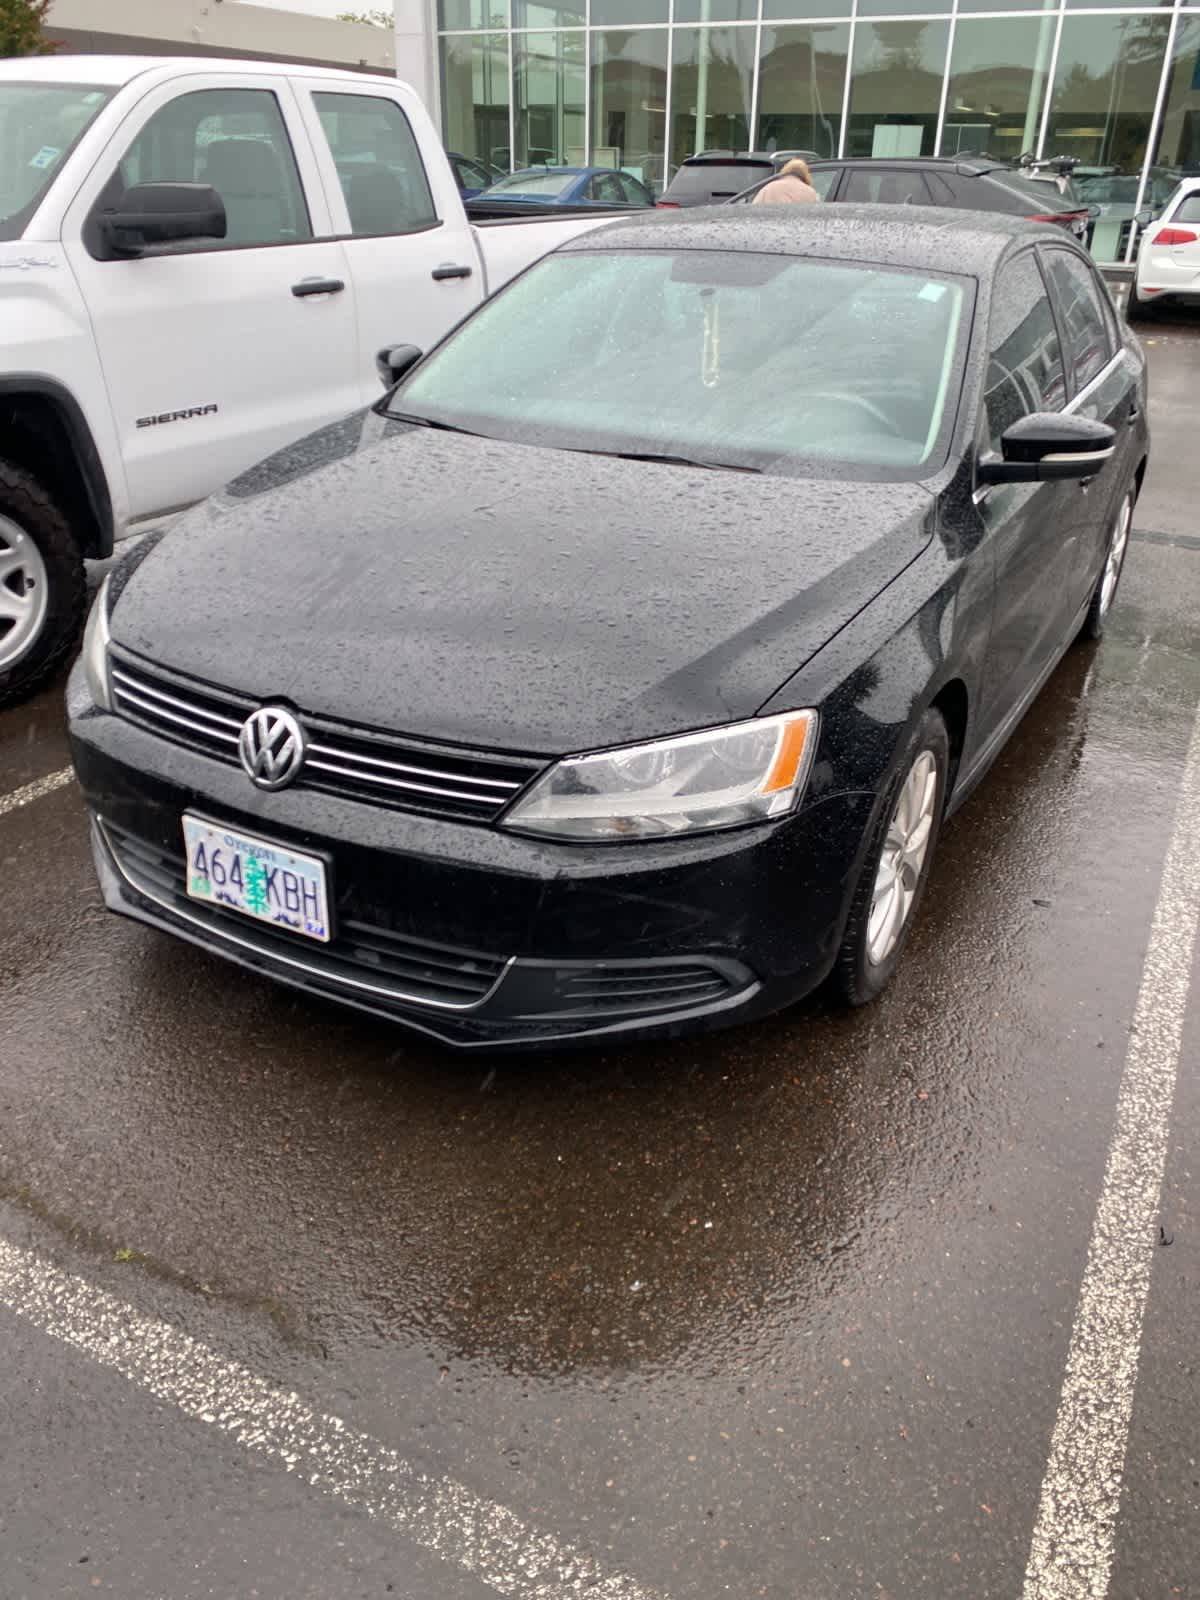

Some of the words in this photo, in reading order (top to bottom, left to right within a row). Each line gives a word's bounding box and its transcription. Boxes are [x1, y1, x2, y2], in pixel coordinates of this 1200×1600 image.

[136, 403, 218, 428] SIERRA
[194, 841, 244, 894] 464
[263, 863, 318, 921] KBH
